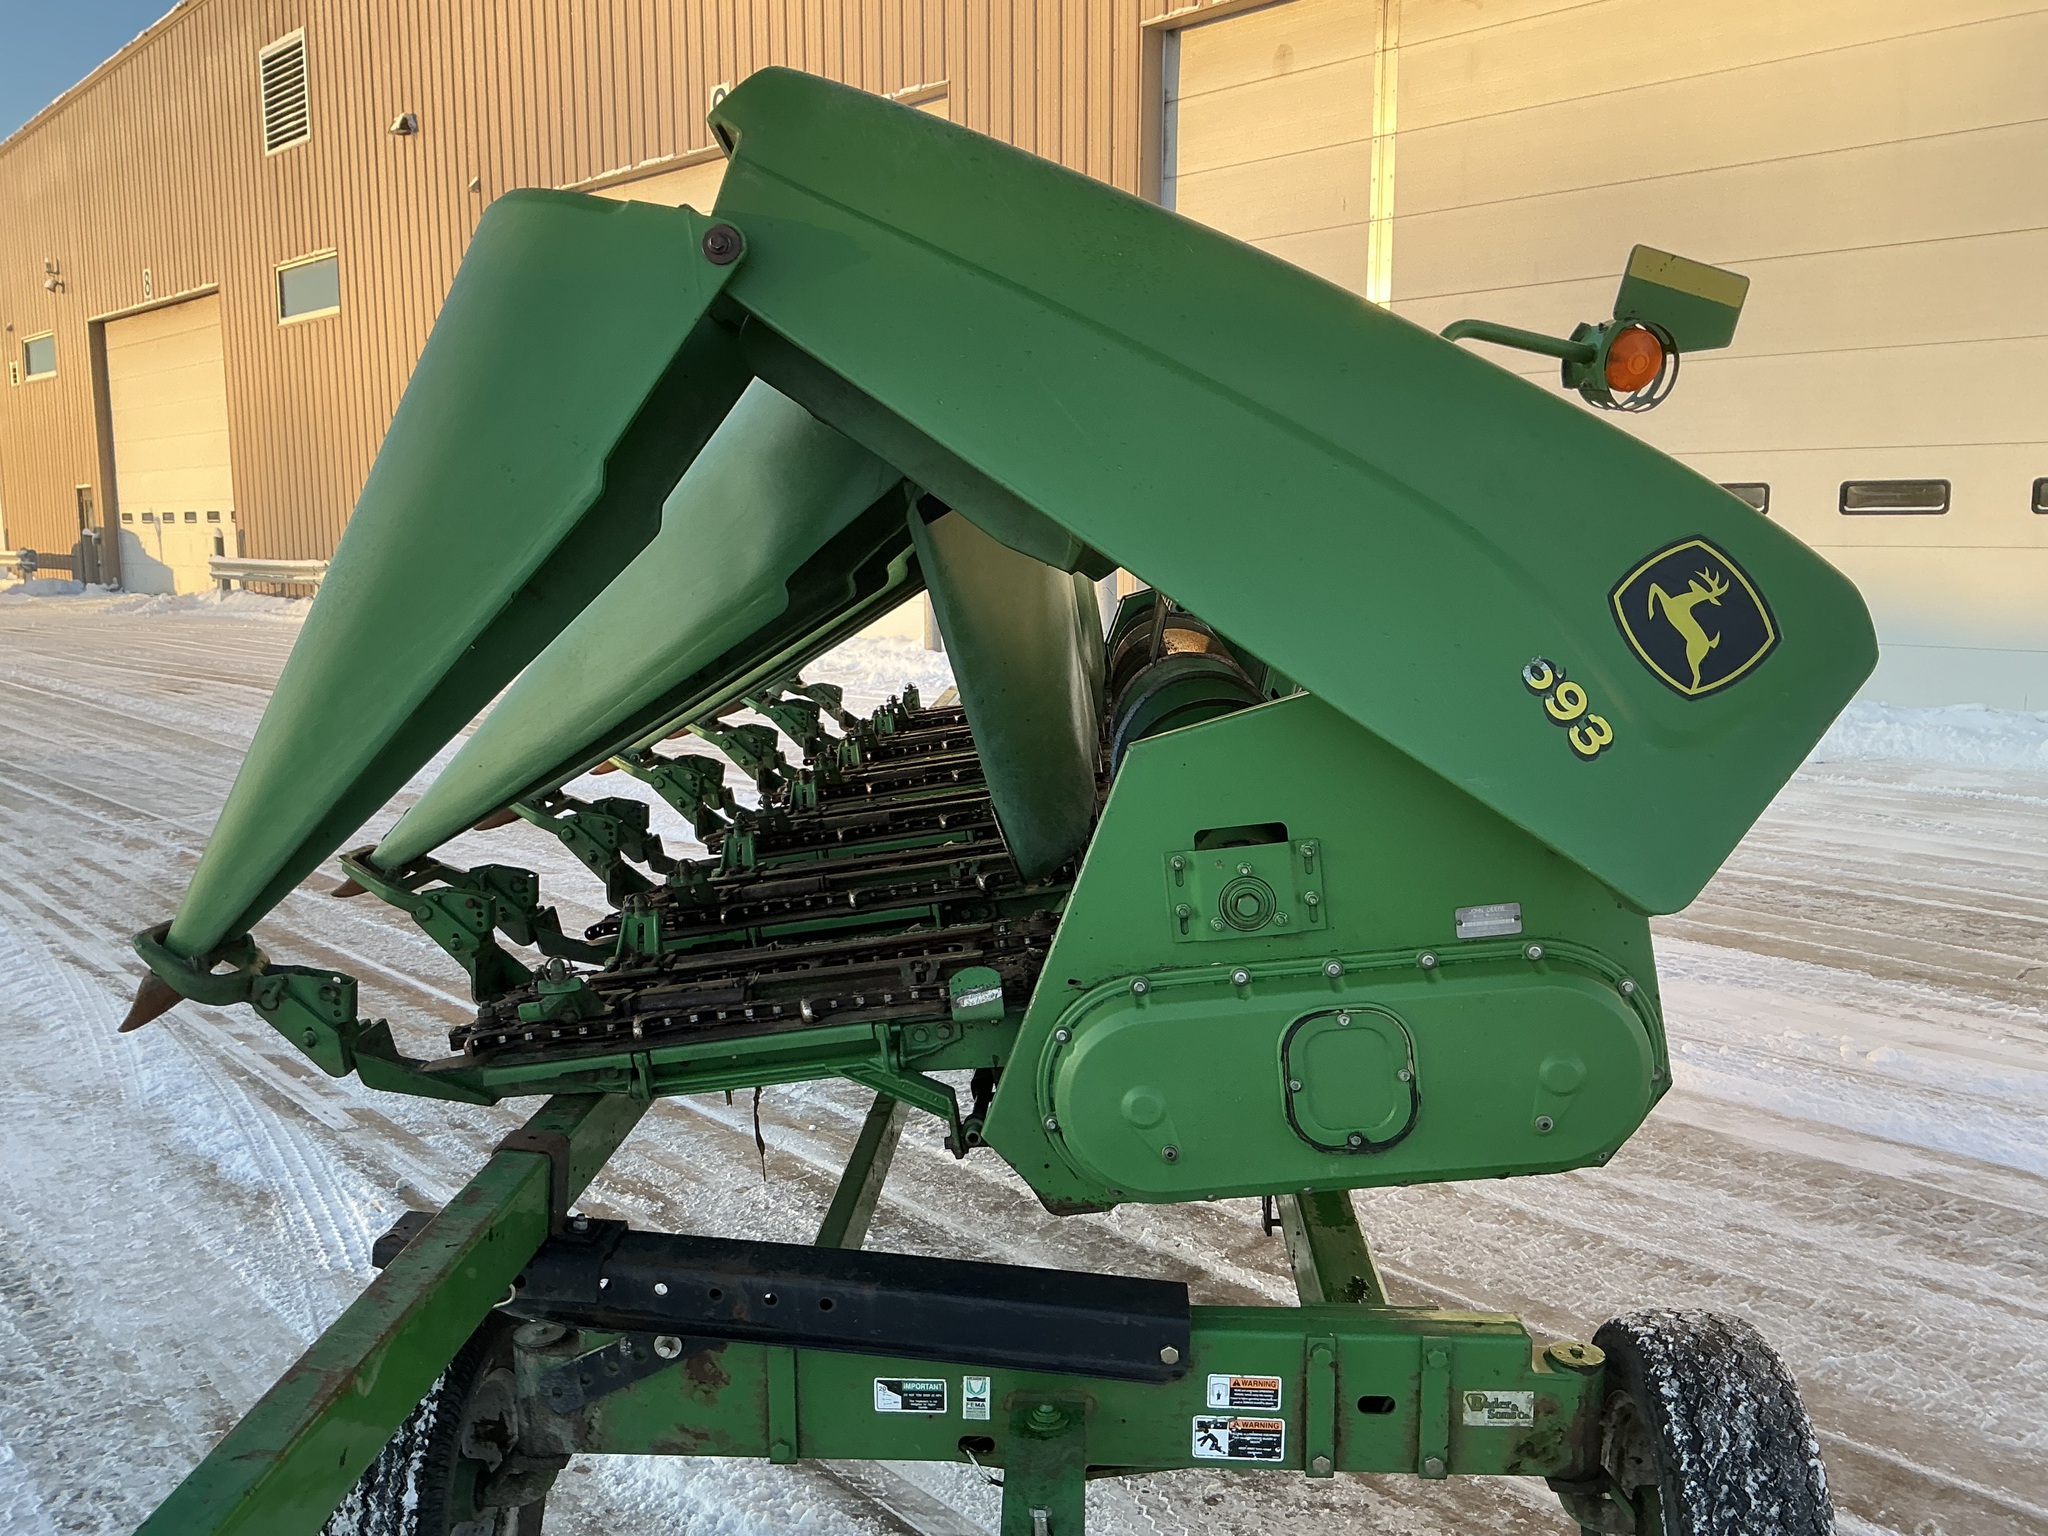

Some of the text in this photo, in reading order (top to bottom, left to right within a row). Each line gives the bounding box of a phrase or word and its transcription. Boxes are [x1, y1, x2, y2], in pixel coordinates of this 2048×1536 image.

[144, 270, 150, 296] 8
[1486, 905, 1505, 913] DEERE
[903, 1382, 943, 1390] IMPORTANT
[1241, 1380, 1277, 1388] WARNING
[1242, 1421, 1279, 1429] WARNING
